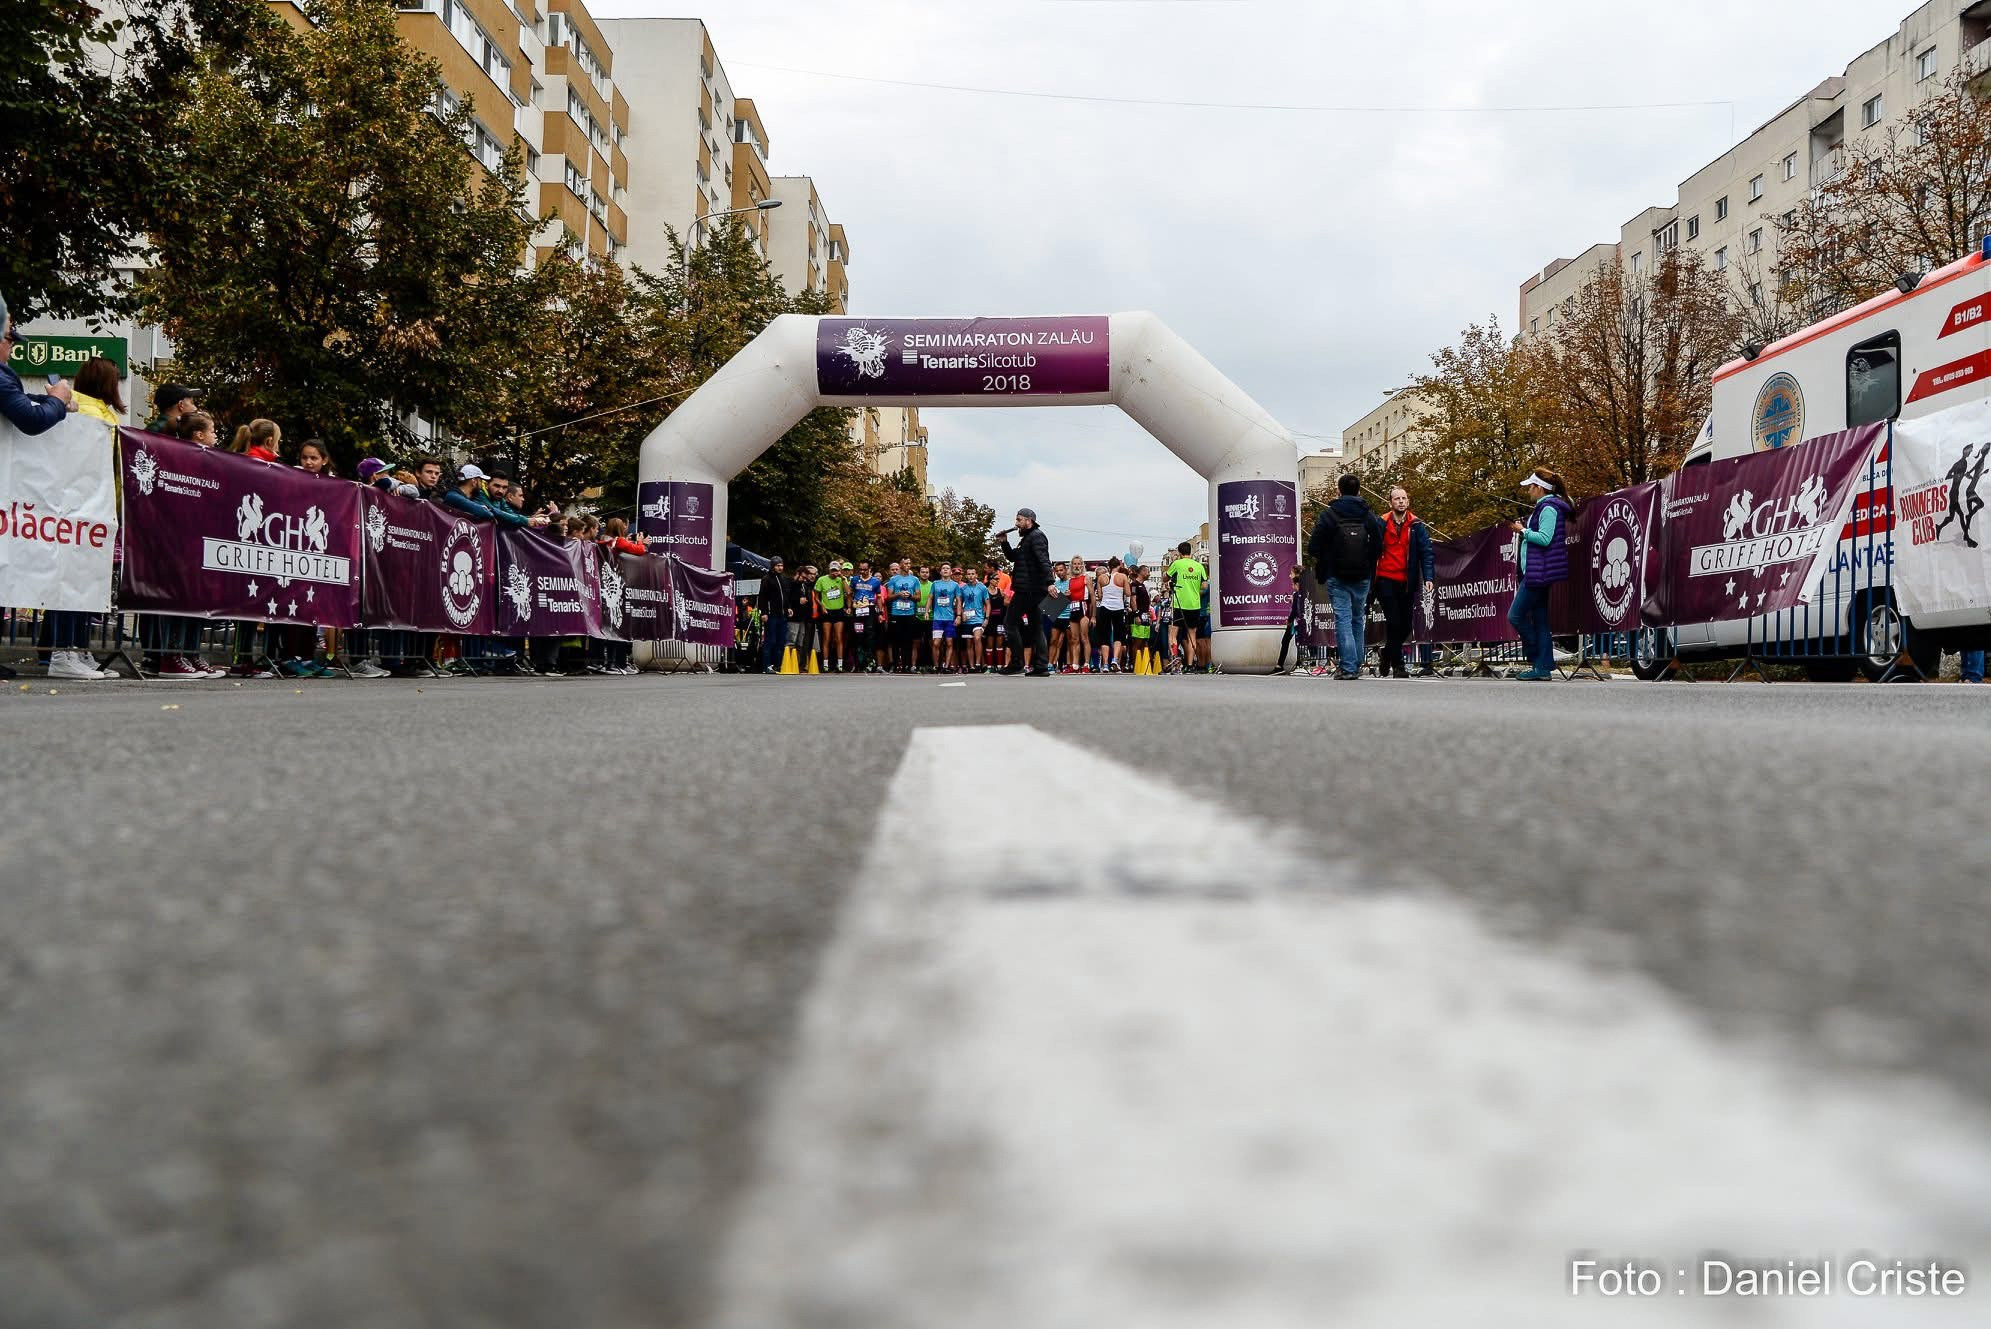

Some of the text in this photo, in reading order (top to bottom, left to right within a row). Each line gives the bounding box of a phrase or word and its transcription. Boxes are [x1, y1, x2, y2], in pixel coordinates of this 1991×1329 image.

[1954, 304, 1982, 326] B1/B2
[903, 328, 1095, 348] SEMIMARATON ZALĂU
[50, 345, 104, 362] Bank
[920, 352, 1037, 369] TenarisSilcotub
[982, 374, 1032, 391] 2018
[159, 470, 201, 486] SEMIMARATON
[1899, 484, 1948, 522] RUNNERS
[1751, 495, 1797, 538] GH
[264, 512, 304, 551] GH
[648, 534, 708, 545] enarisSilcotub
[1231, 533, 1295, 544] TenarisSilcotub
[1592, 503, 1641, 569] BOGLAR CHAMP
[1912, 515, 1936, 546] CLUB
[441, 521, 482, 584] BOGLAR CHAMP
[1700, 527, 1826, 570] GRIFF HOTEL
[216, 544, 341, 580] GRIFF HOTEL
[1223, 594, 1268, 605] VAXICUM
[1437, 580, 1494, 600] SEMIMARATON
[1446, 601, 1497, 620] TenarisSilcotub
